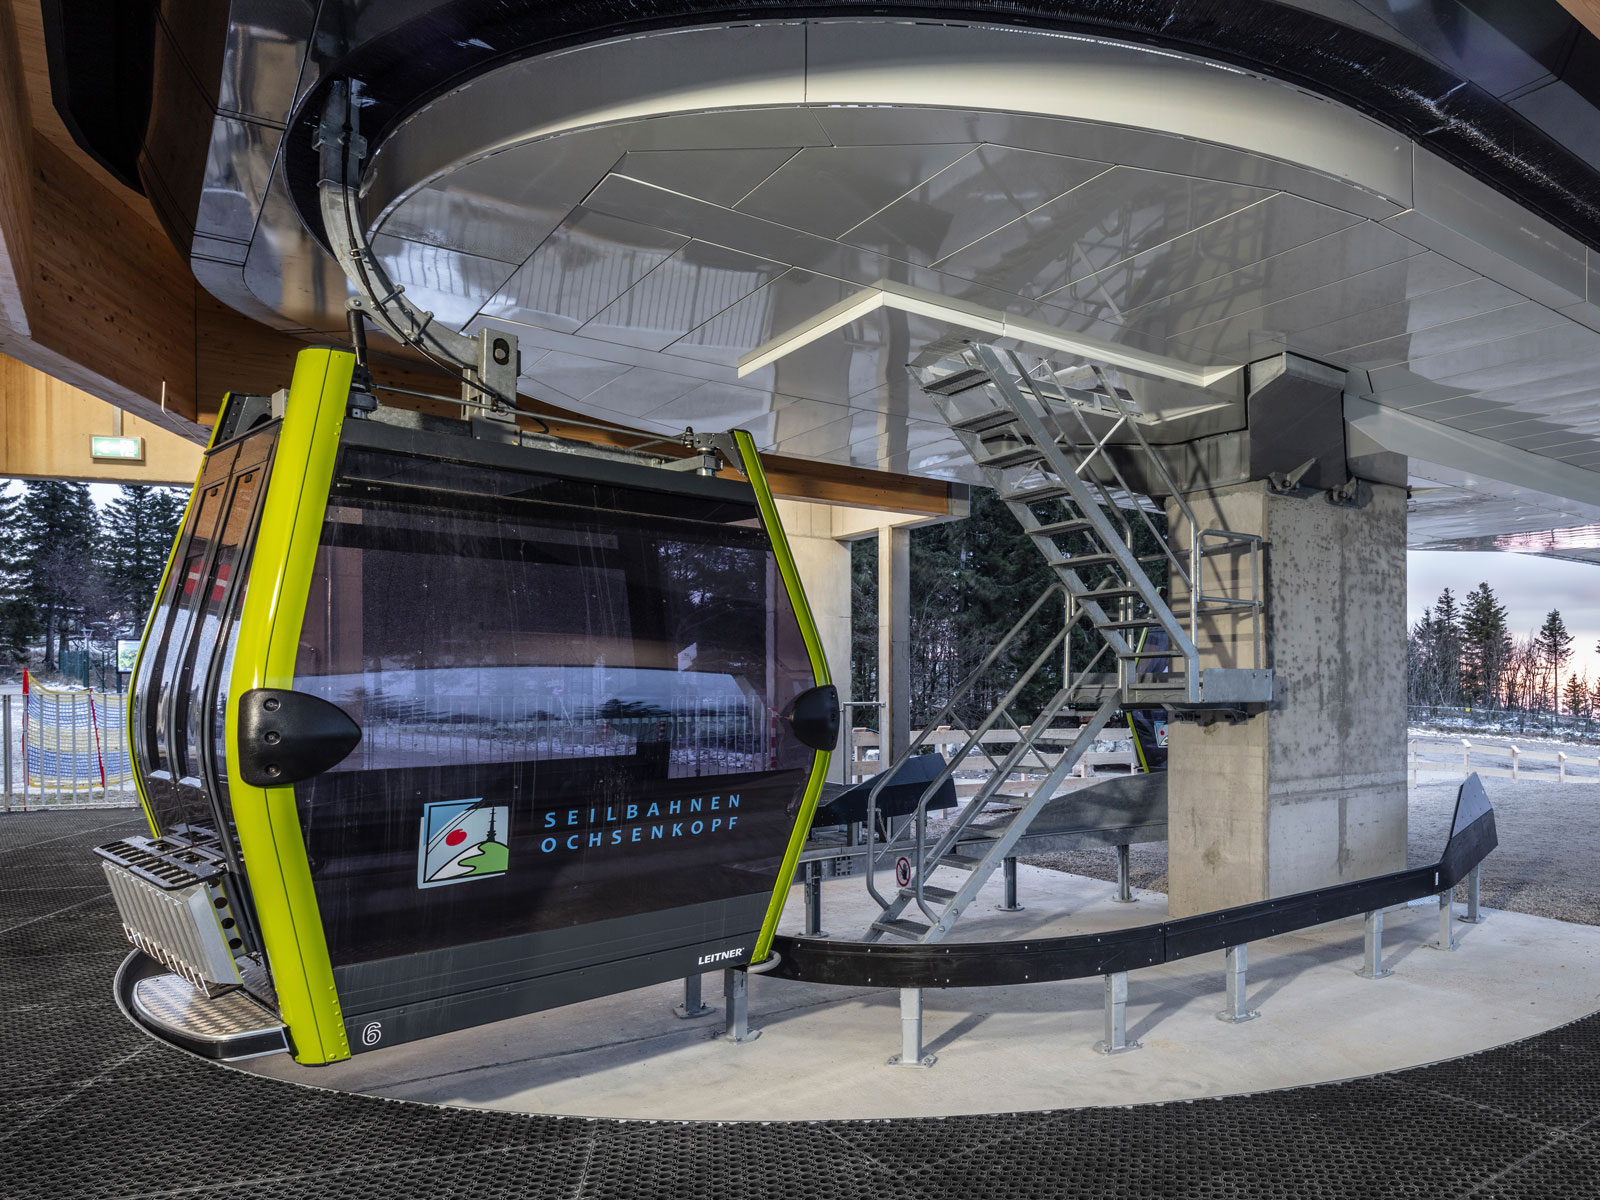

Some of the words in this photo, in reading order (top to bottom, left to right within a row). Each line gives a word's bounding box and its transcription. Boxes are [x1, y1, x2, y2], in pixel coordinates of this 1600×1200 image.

[544, 794, 740, 828] SEILBAHNEN
[541, 816, 738, 853] OCHSENKOPF
[698, 947, 743, 966] LEITNER
[362, 1021, 382, 1046] 6
